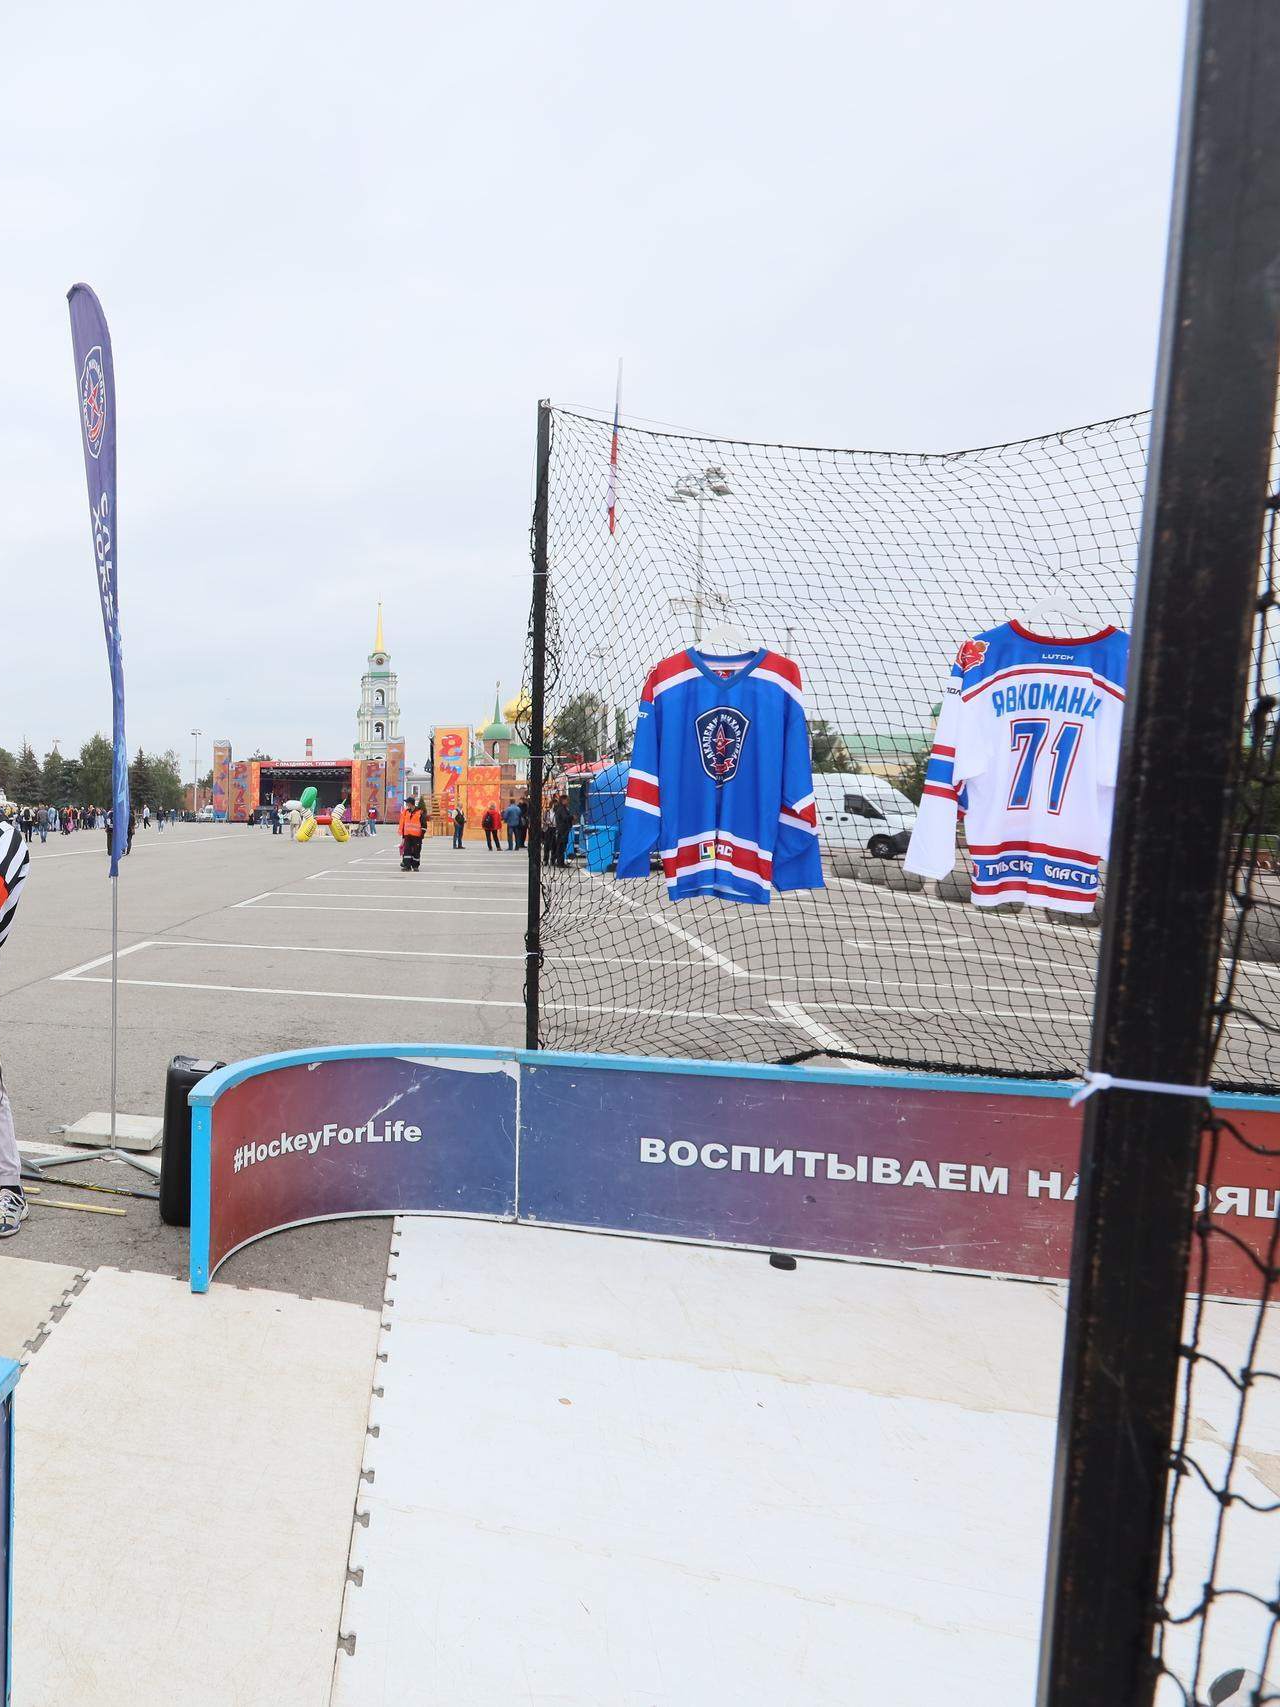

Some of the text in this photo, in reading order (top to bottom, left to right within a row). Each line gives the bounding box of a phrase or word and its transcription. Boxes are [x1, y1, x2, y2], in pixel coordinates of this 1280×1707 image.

[1042, 653, 1074, 661] LUTCH
[1007, 718, 1084, 816] 71
[233, 1120, 422, 1174] #HockeyForLife
[640, 1137, 1010, 1196] ВОСПИТЫВАЕМ
